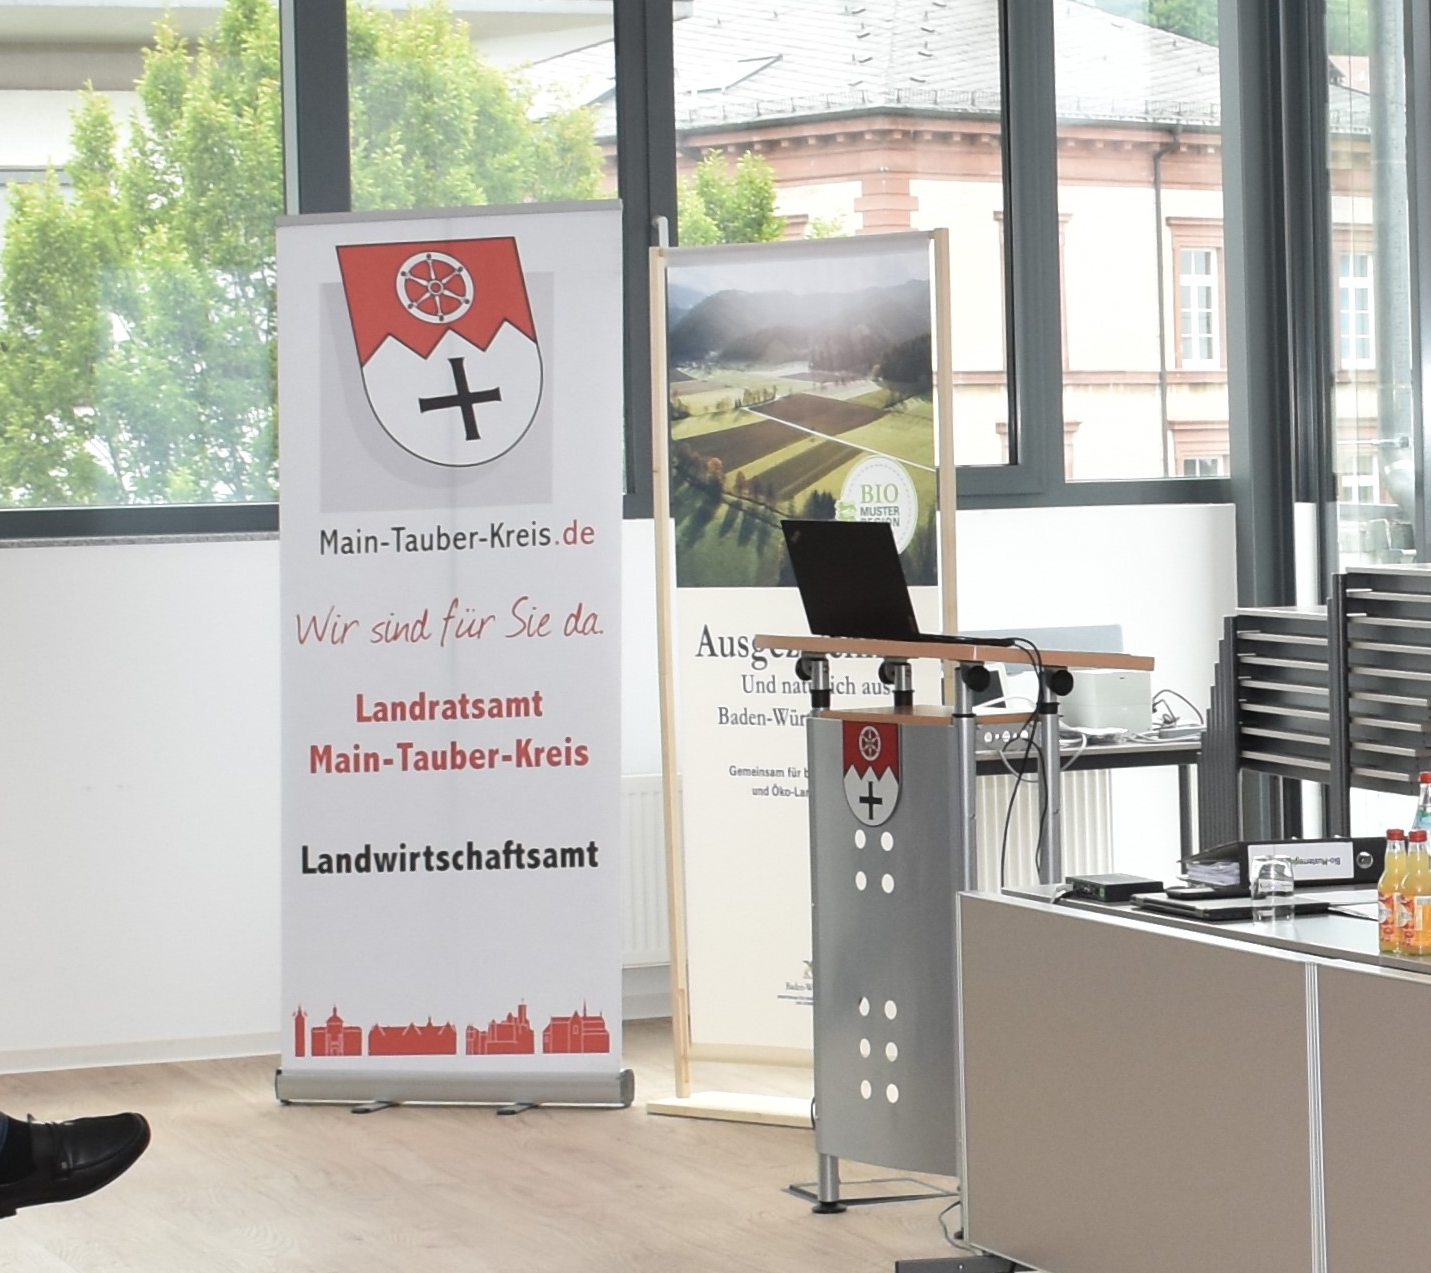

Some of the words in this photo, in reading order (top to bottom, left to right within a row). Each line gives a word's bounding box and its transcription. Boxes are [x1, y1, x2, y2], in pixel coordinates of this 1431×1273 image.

[860, 482, 899, 504] BIO
[860, 505, 900, 517] MUSTER
[319, 519, 596, 555] Main-Tauber-Kreis.de
[296, 604, 360, 645] Wir
[370, 608, 432, 644] sind
[440, 596, 496, 647] für
[505, 595, 552, 639] Sie
[562, 602, 605, 637] da.
[741, 674, 777, 694] Und
[862, 681, 892, 696] aus
[355, 690, 544, 723] Landratsamt
[309, 736, 590, 774] Main-Tauber-Kreis
[729, 765, 785, 777] Gemeinsam
[787, 766, 801, 778] für
[752, 785, 770, 796] und
[301, 840, 599, 875] Landwirtschaftsamt
